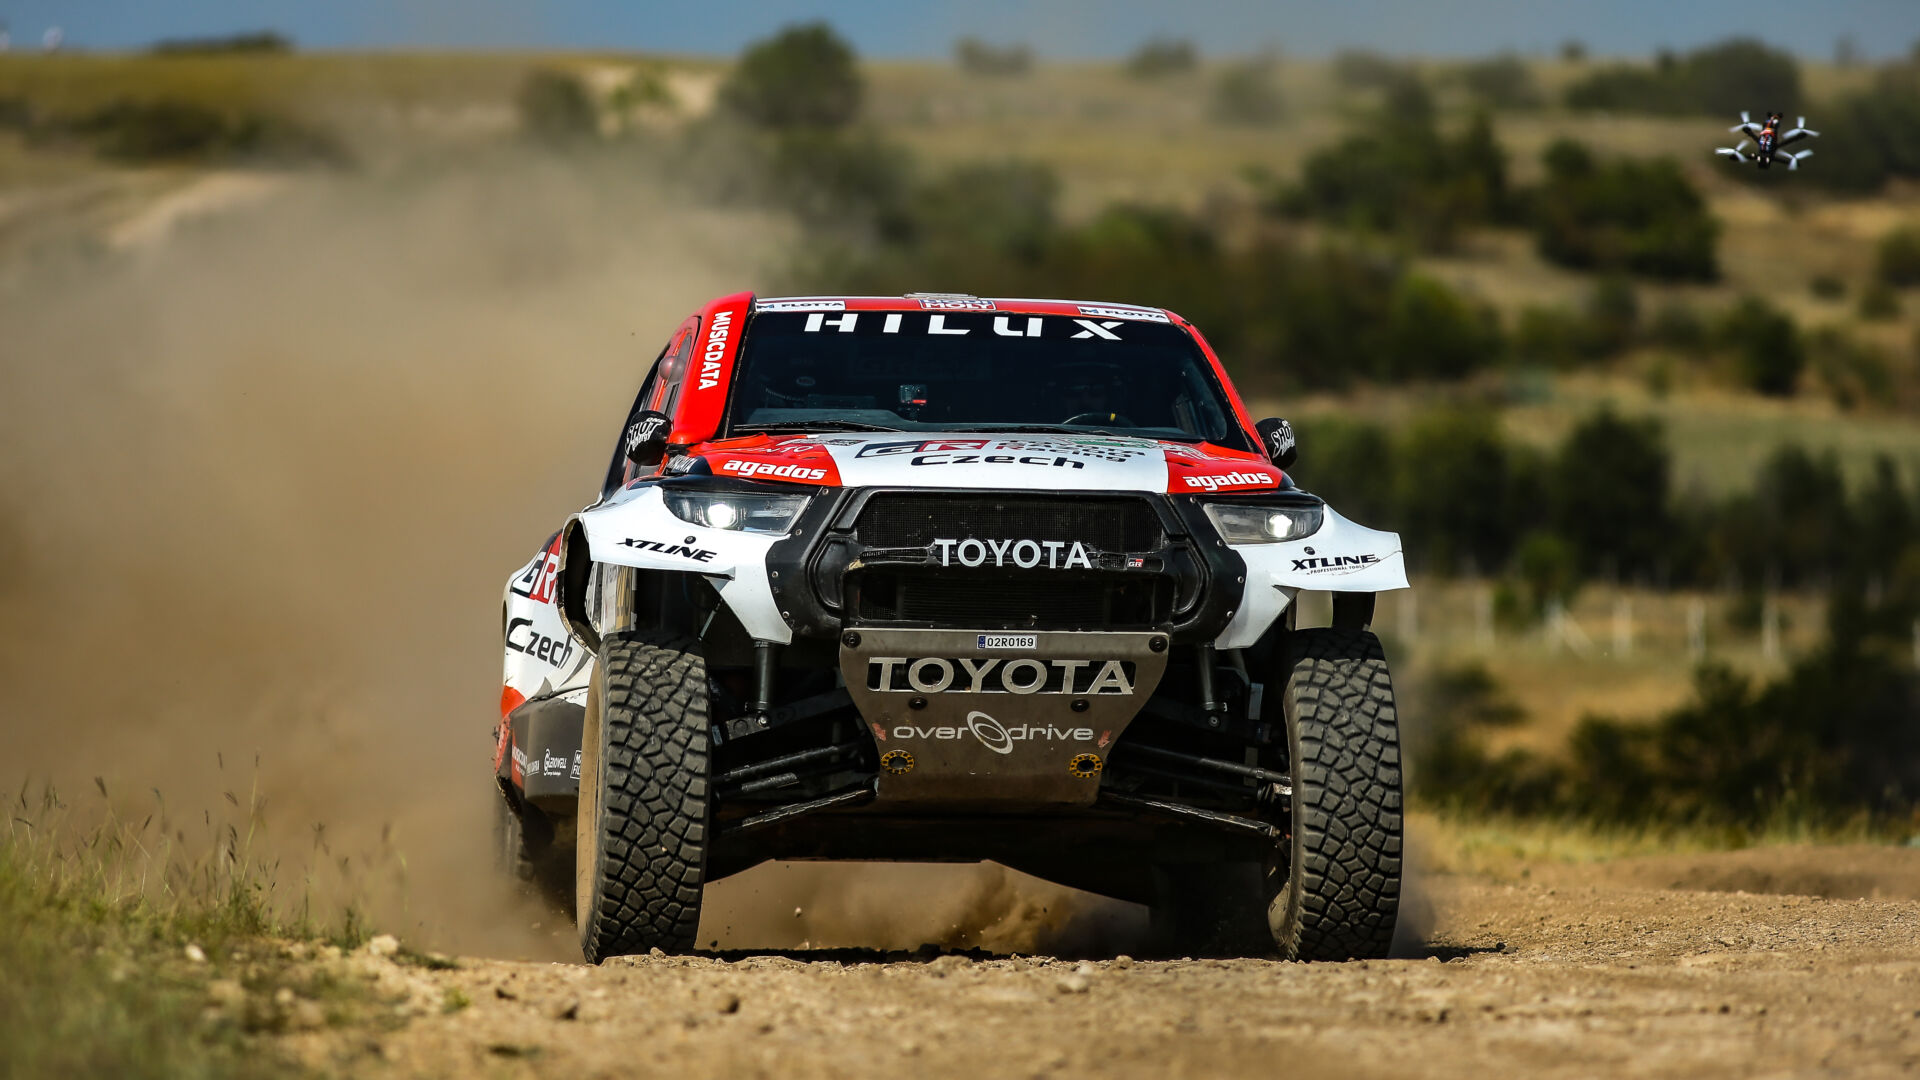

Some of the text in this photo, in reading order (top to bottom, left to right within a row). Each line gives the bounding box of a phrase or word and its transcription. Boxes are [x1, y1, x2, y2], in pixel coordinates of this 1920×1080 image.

[1104, 310, 1167, 319] FLOTTA
[804, 313, 1124, 340] HILUX
[698, 311, 733, 390] MUSICDATA
[856, 440, 991, 458] GR
[723, 459, 828, 480] agados
[911, 453, 1085, 469] Czech
[1182, 471, 1273, 491] agados
[616, 537, 718, 563] XTLINE
[934, 538, 1092, 569] TOYOTA
[1128, 560, 1144, 568] GR
[1291, 554, 1380, 571] XTLINE
[1310, 566, 1348, 574] PROFESSIONAL
[505, 617, 573, 670] Czech
[869, 656, 1134, 695] TOYOTA
